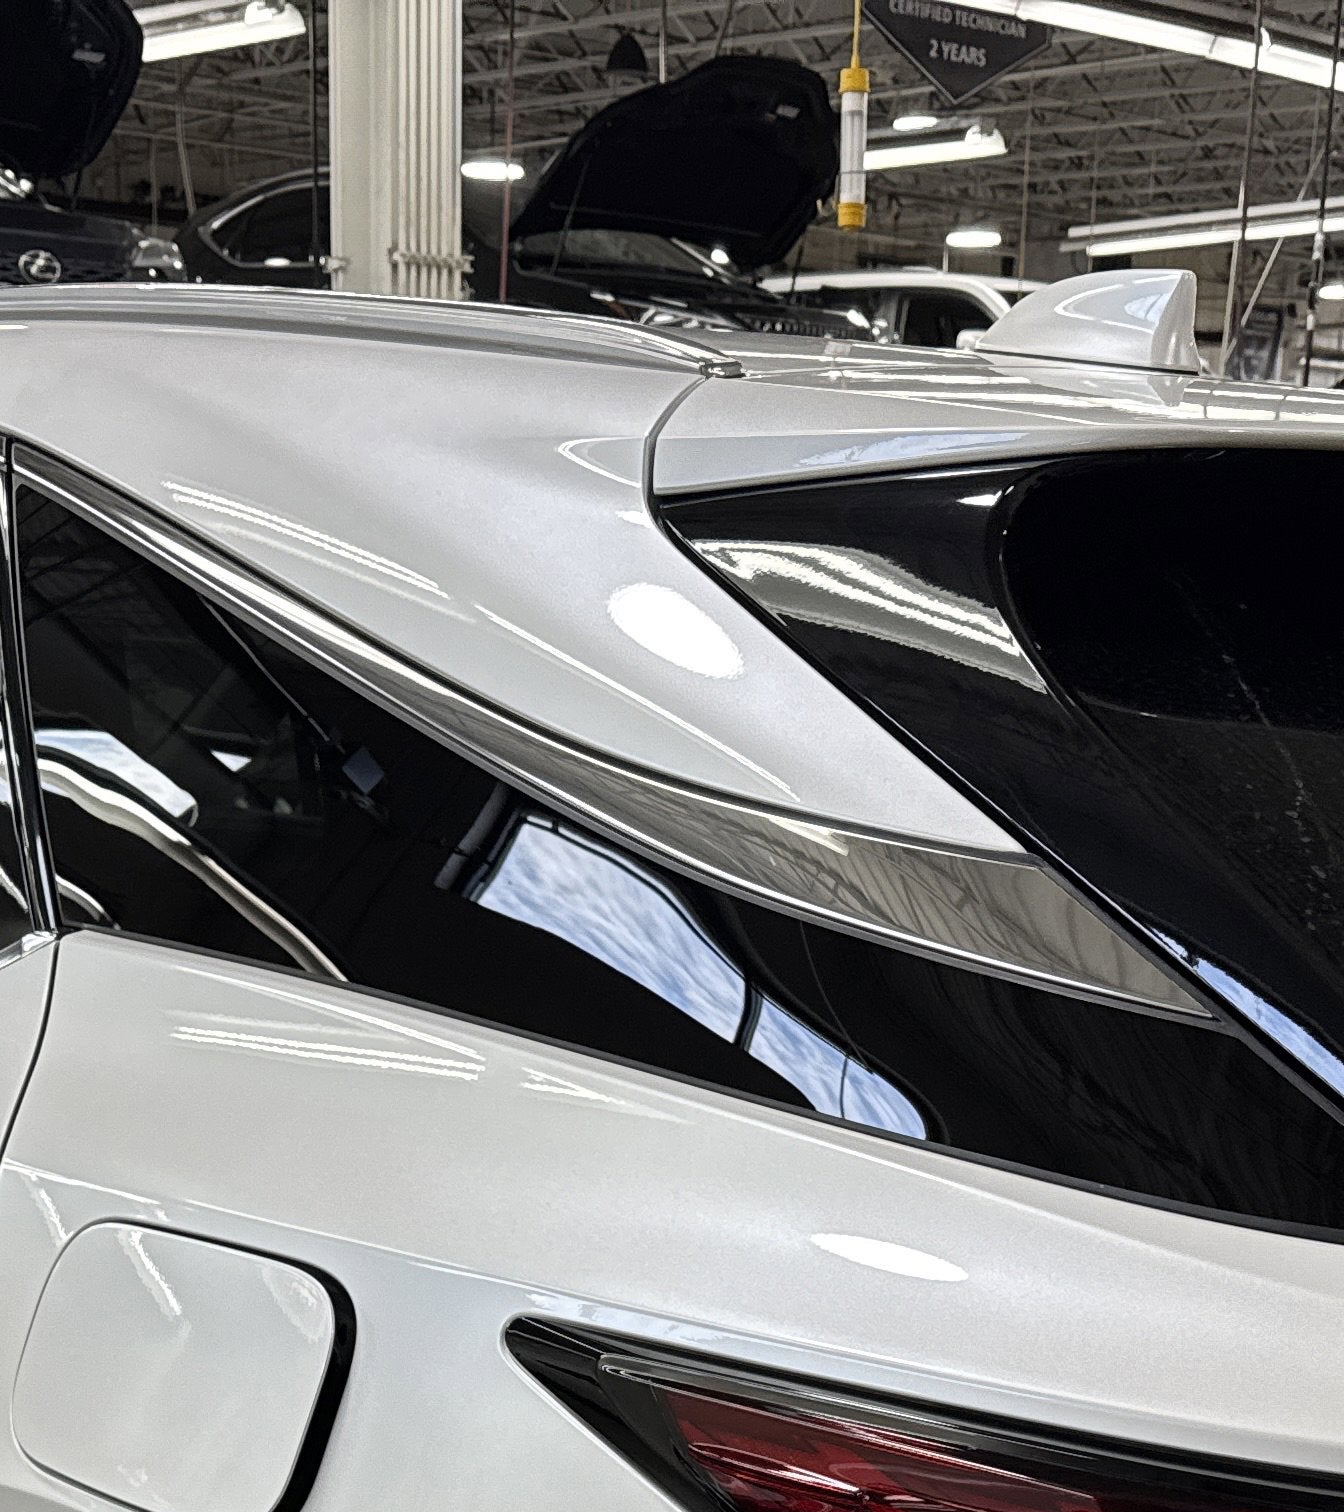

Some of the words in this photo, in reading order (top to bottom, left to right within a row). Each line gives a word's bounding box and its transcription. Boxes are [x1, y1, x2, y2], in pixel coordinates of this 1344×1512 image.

[888, 0, 953, 24] CERTIFIED
[955, 10, 1027, 39] TECHNICIAN
[929, 39, 939, 59] 2
[941, 40, 987, 68] YEARS
